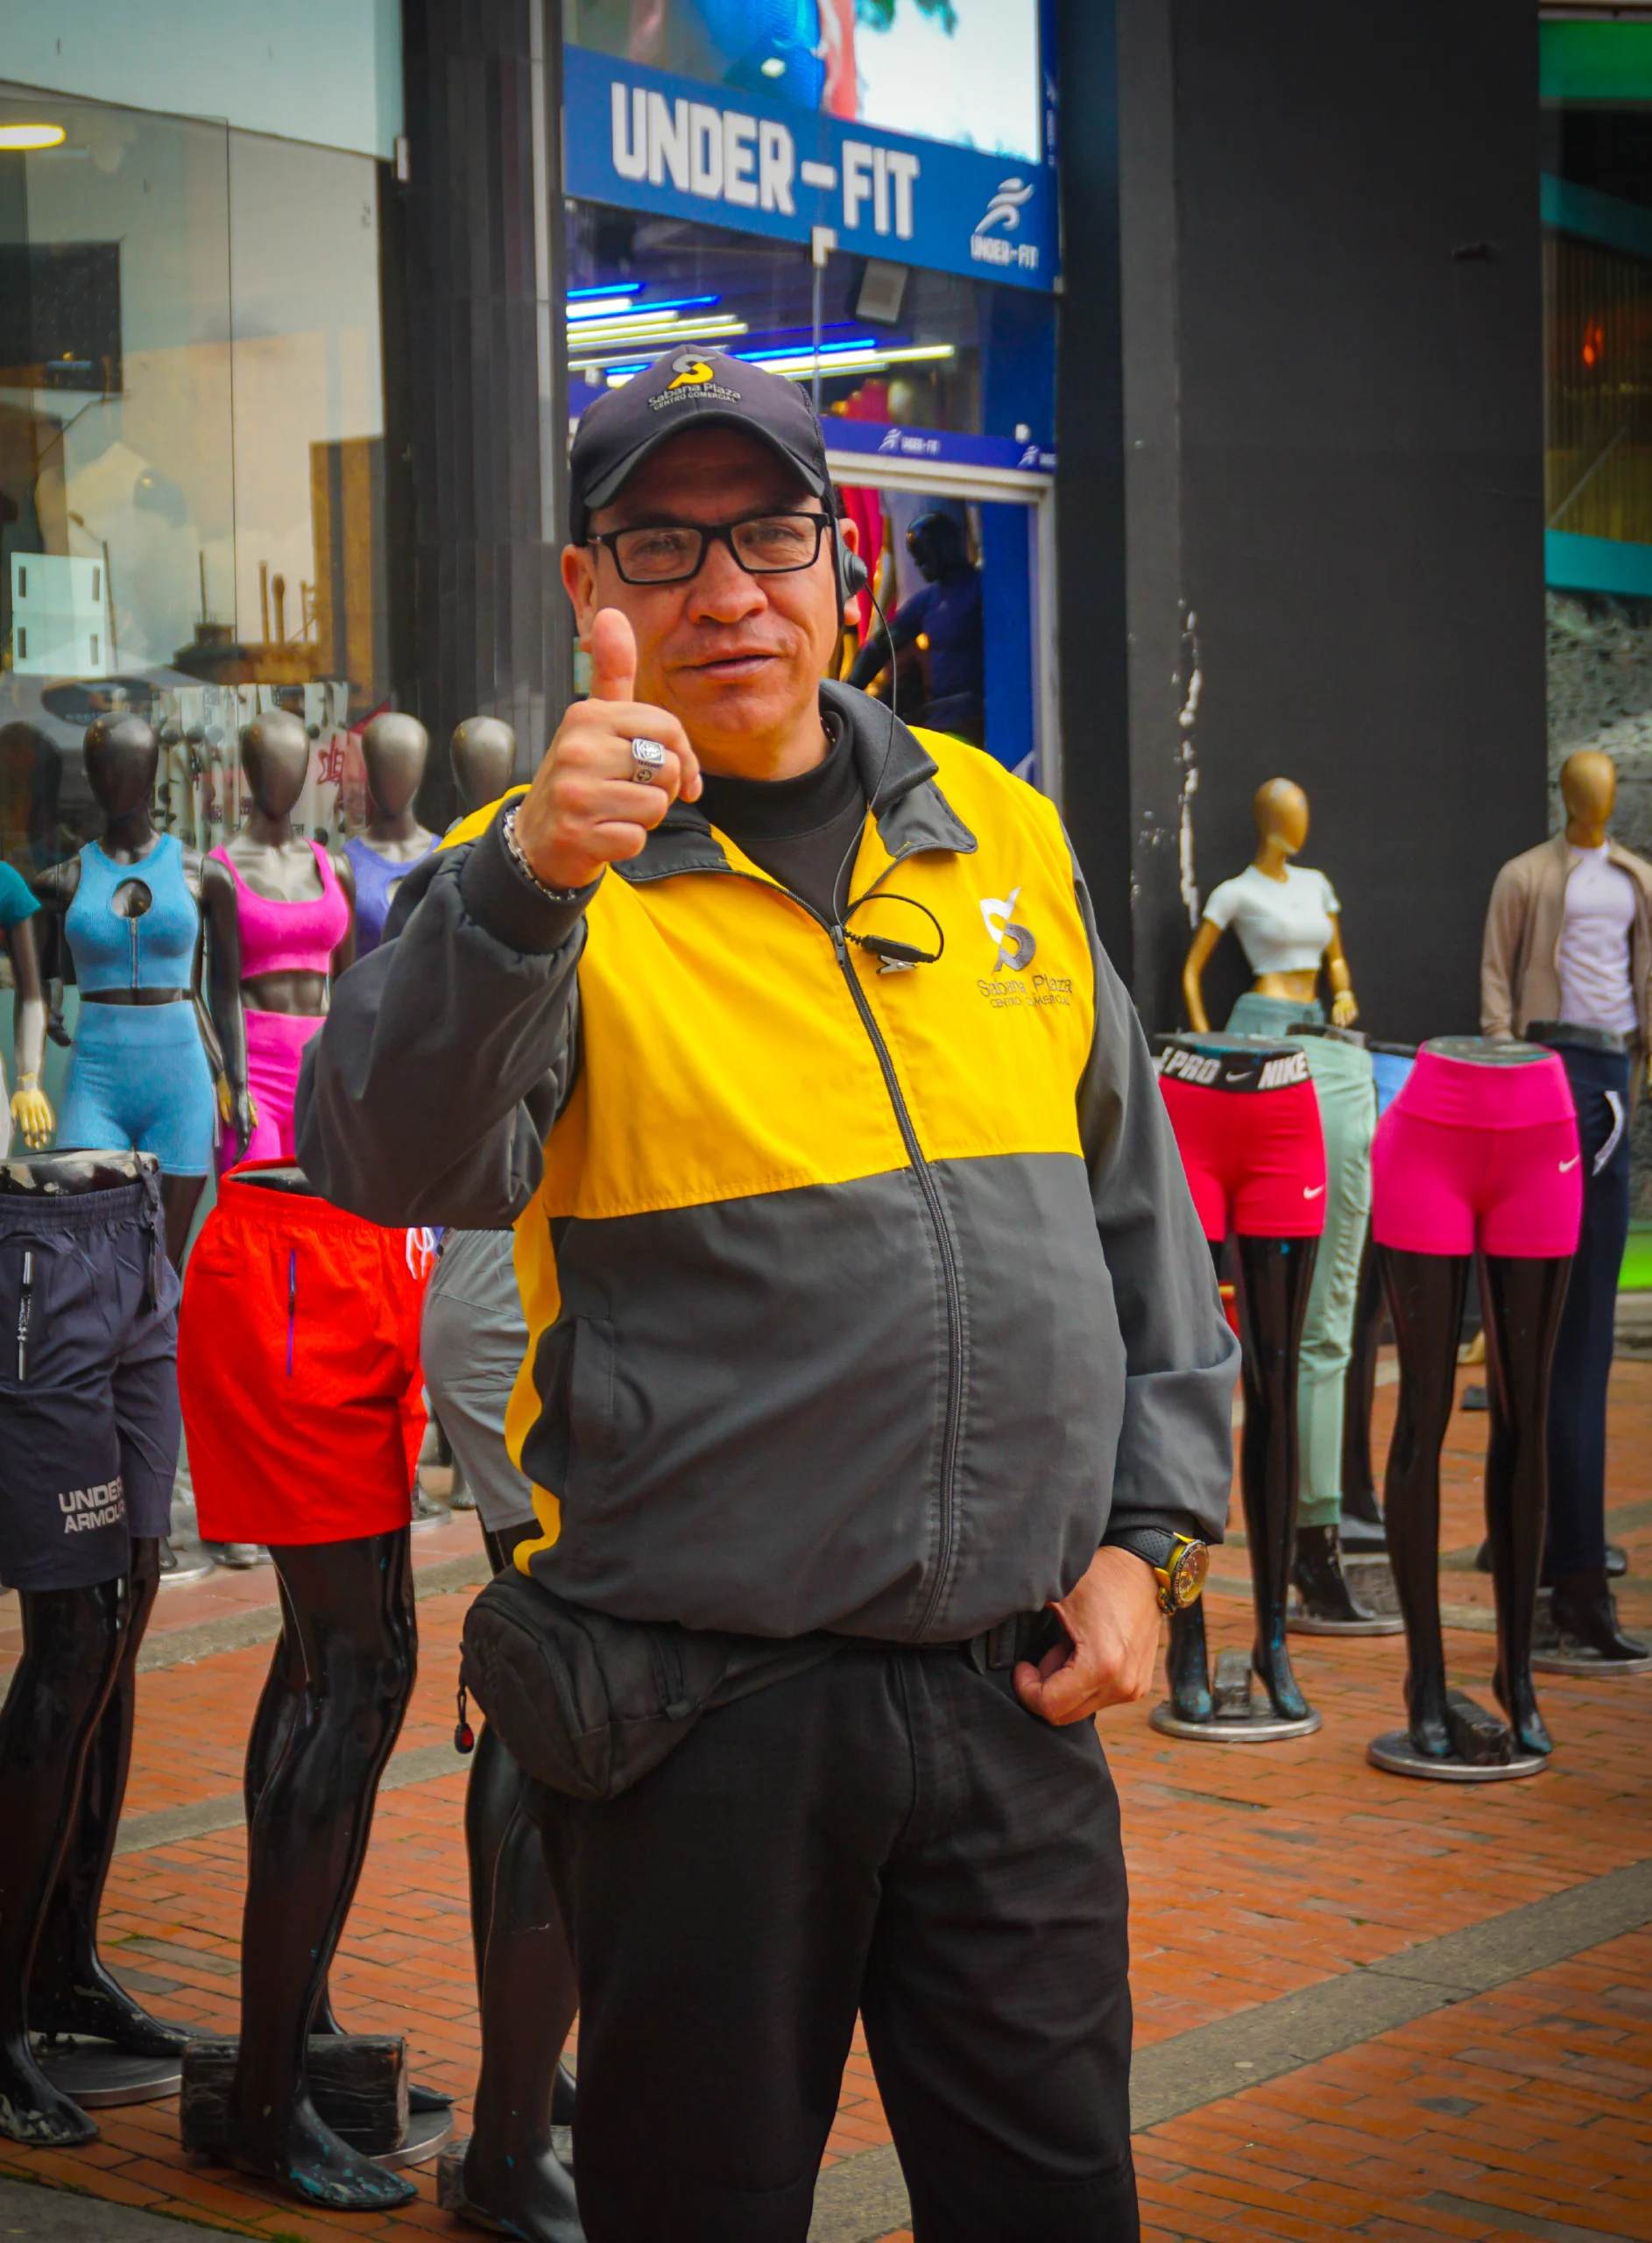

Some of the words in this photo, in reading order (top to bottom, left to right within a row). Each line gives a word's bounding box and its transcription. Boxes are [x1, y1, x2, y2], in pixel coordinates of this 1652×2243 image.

[648, 385, 701, 407] Sabana
[703, 382, 742, 400] Plaza
[653, 392, 687, 410] CENTRO
[688, 391, 738, 403] COMERCIAL
[977, 978, 1027, 997] Sabana
[1032, 973, 1073, 994] Plaza
[990, 996, 1022, 1008] CENTRO
[1165, 1050, 1222, 1085] PRO
[1258, 1051, 1309, 1090] NIKE
[58, 1475, 123, 1513] UNDER
